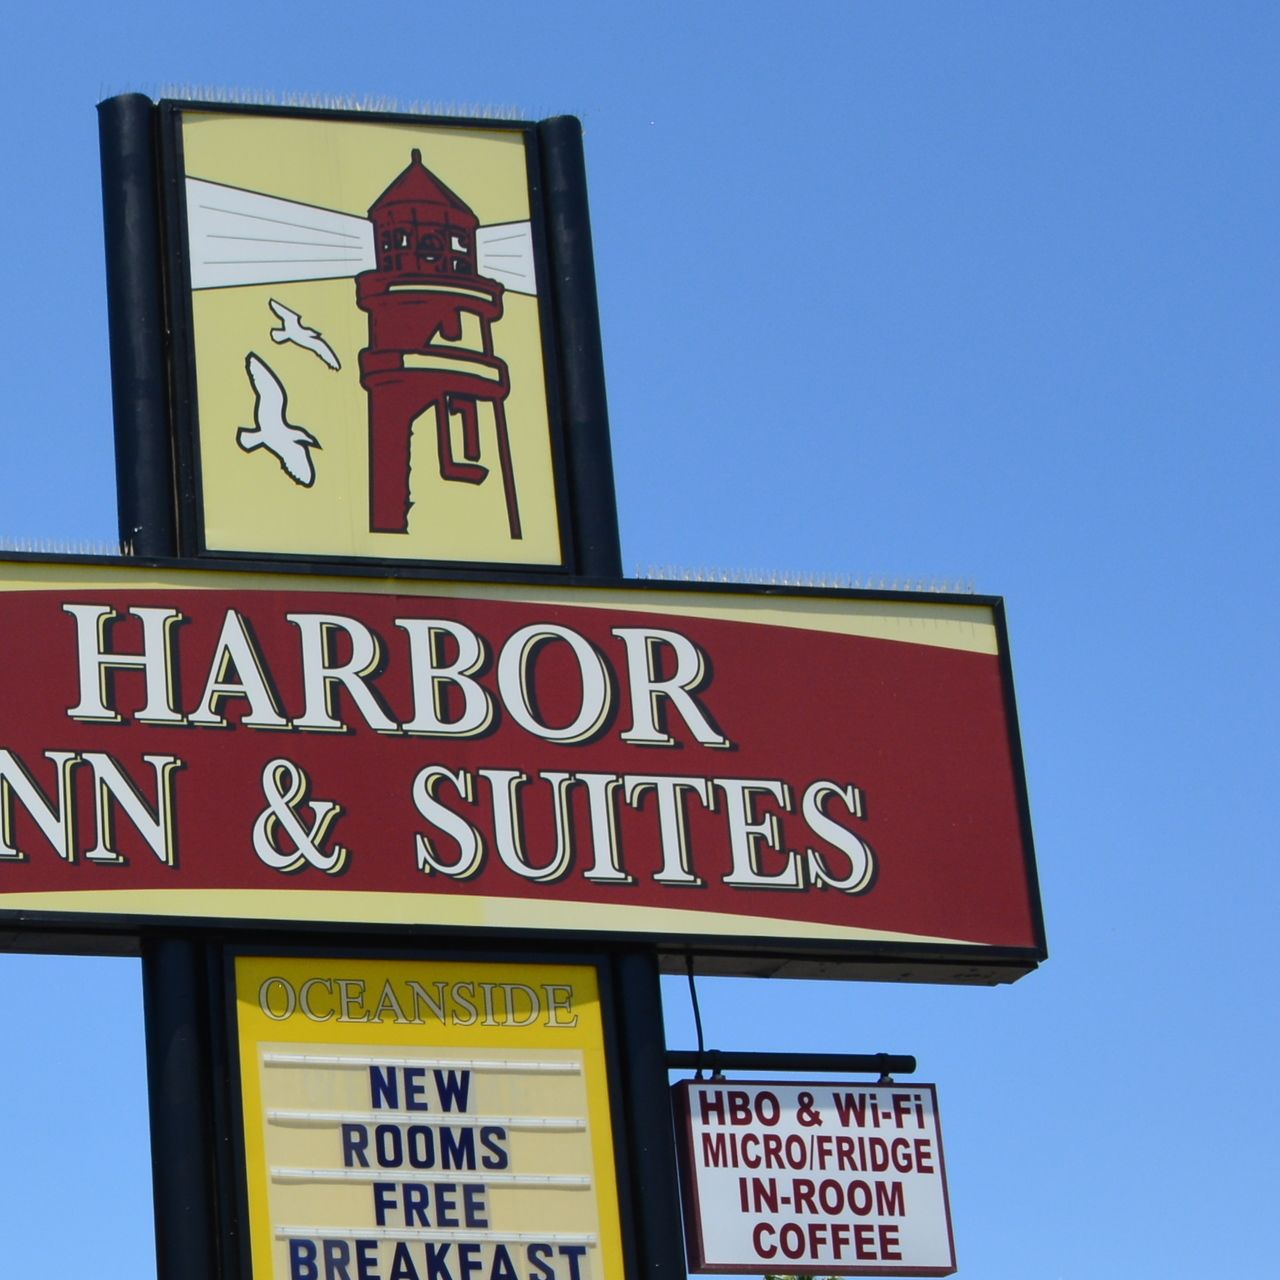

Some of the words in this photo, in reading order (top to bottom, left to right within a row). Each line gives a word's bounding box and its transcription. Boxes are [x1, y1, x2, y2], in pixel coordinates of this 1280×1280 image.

[61, 602, 731, 749] HARBOR
[250, 758, 349, 875] &
[413, 764, 877, 896] SUITES
[258, 976, 579, 1028] OCEANSIDE
[368, 1065, 472, 1113] NEW
[697, 1089, 781, 1127] HBO
[796, 1091, 824, 1128] &
[832, 1092, 926, 1130] Wi-Fi
[341, 1123, 509, 1171] ROOMS
[701, 1132, 935, 1175] MICRO/FRIDGE
[372, 1182, 489, 1229] FREE
[738, 1176, 907, 1218] IN-ROOM
[751, 1221, 904, 1261] COFFEE
